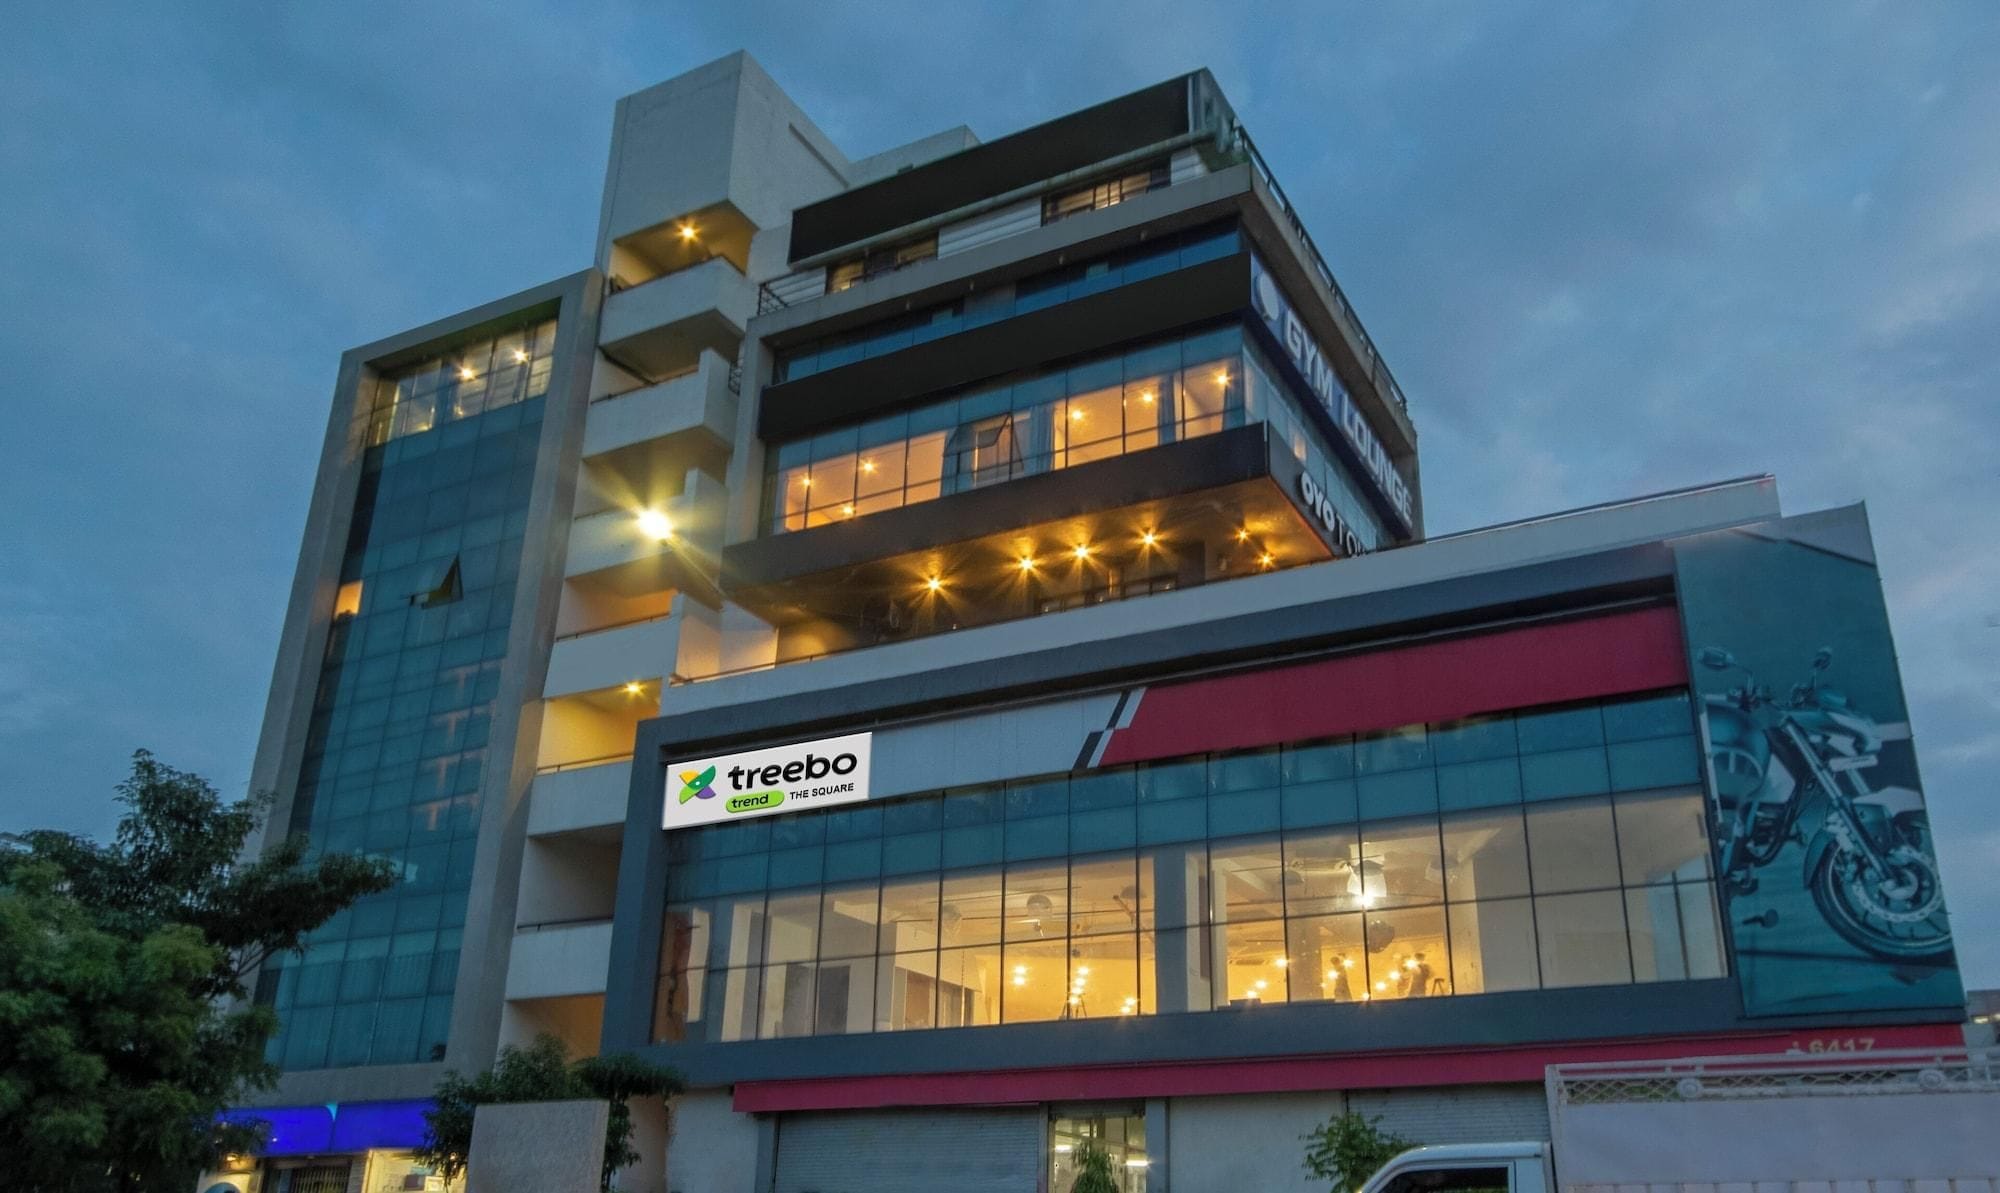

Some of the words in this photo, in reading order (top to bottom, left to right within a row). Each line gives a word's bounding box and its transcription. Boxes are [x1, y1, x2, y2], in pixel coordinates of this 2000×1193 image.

[1286, 310, 1333, 407] GYM
[1343, 393, 1413, 529] LOUNGE
[1301, 470, 1335, 532] OYO
[727, 752, 858, 791] treebo
[731, 793, 769, 809] trend
[789, 789, 809, 801] THE
[811, 782, 855, 798] SQUARE
